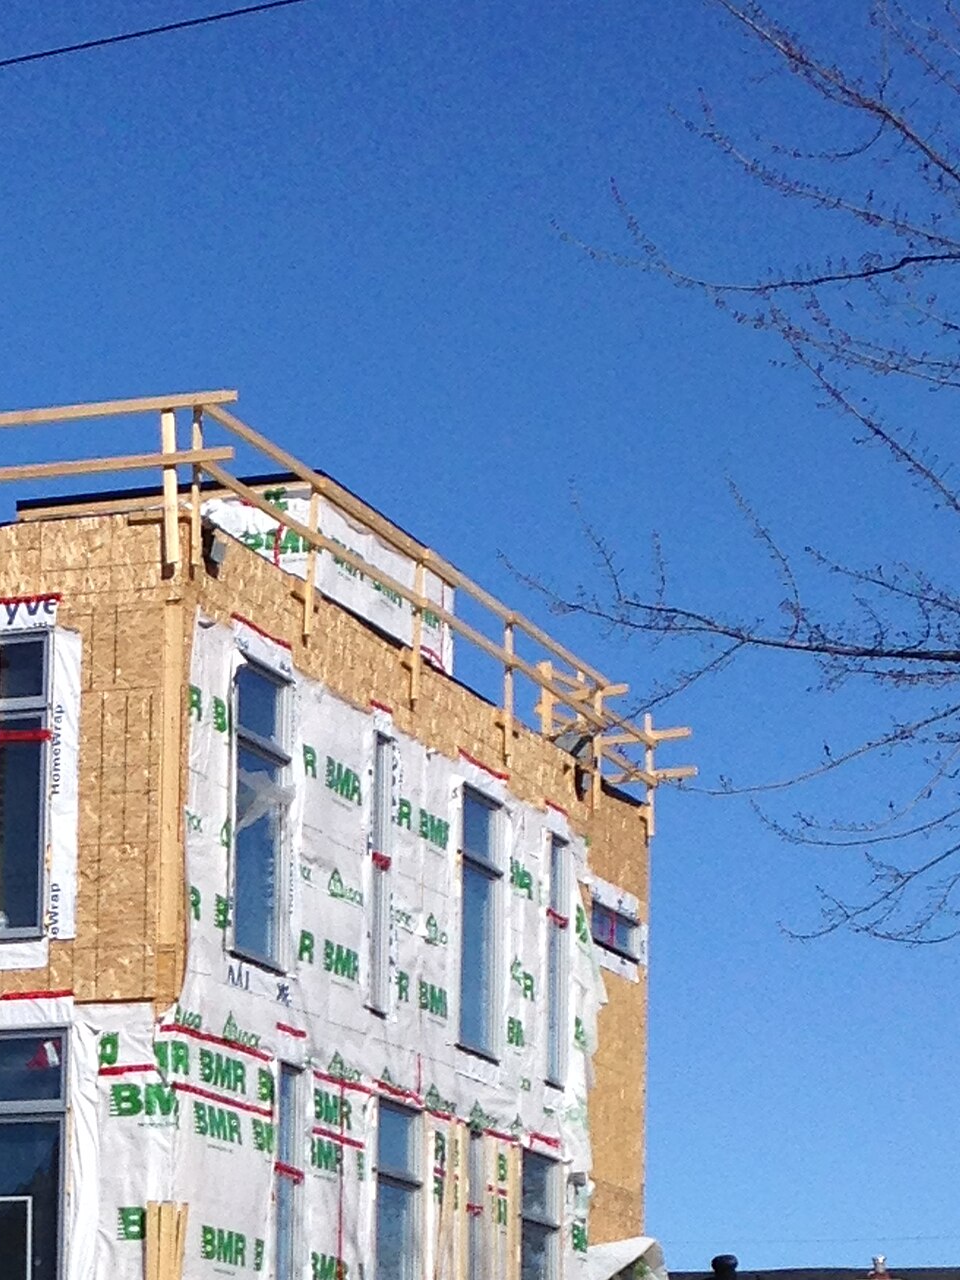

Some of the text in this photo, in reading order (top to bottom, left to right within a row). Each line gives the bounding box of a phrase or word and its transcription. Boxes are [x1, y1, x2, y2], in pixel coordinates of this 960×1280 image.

[199, 1048, 247, 1095] BMR
[109, 1082, 179, 1118] BM
[193, 1101, 243, 1146] BMR
[201, 1225, 247, 1268] BMR
